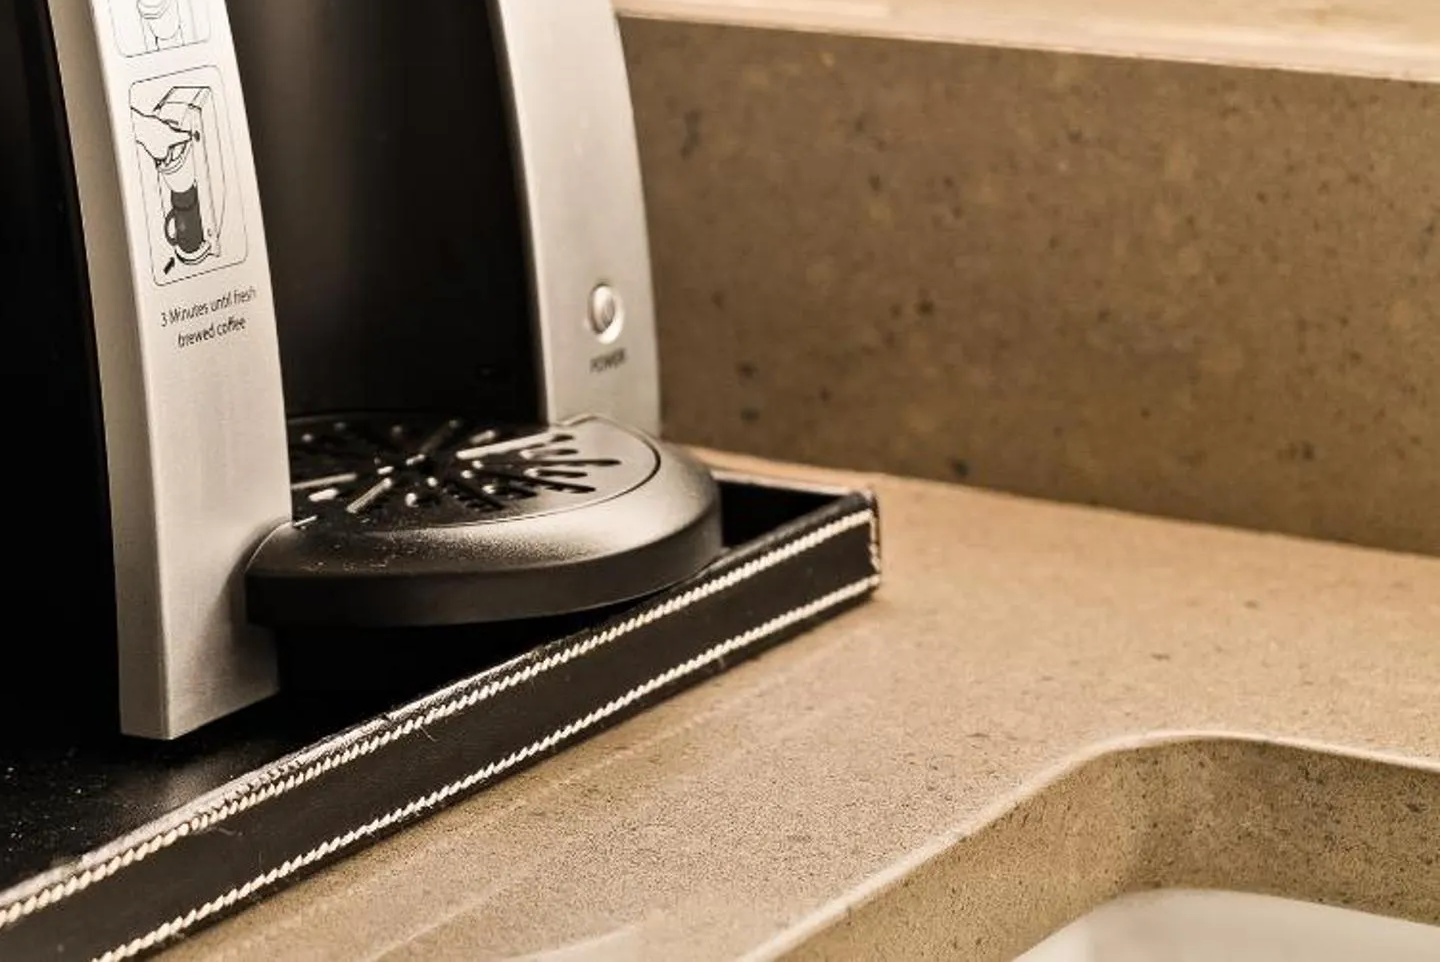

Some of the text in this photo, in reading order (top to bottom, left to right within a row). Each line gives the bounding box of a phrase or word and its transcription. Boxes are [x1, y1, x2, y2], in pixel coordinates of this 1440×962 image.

[160, 285, 257, 327] 3 Minutes until fresh
[177, 315, 247, 348] brewed coffee
